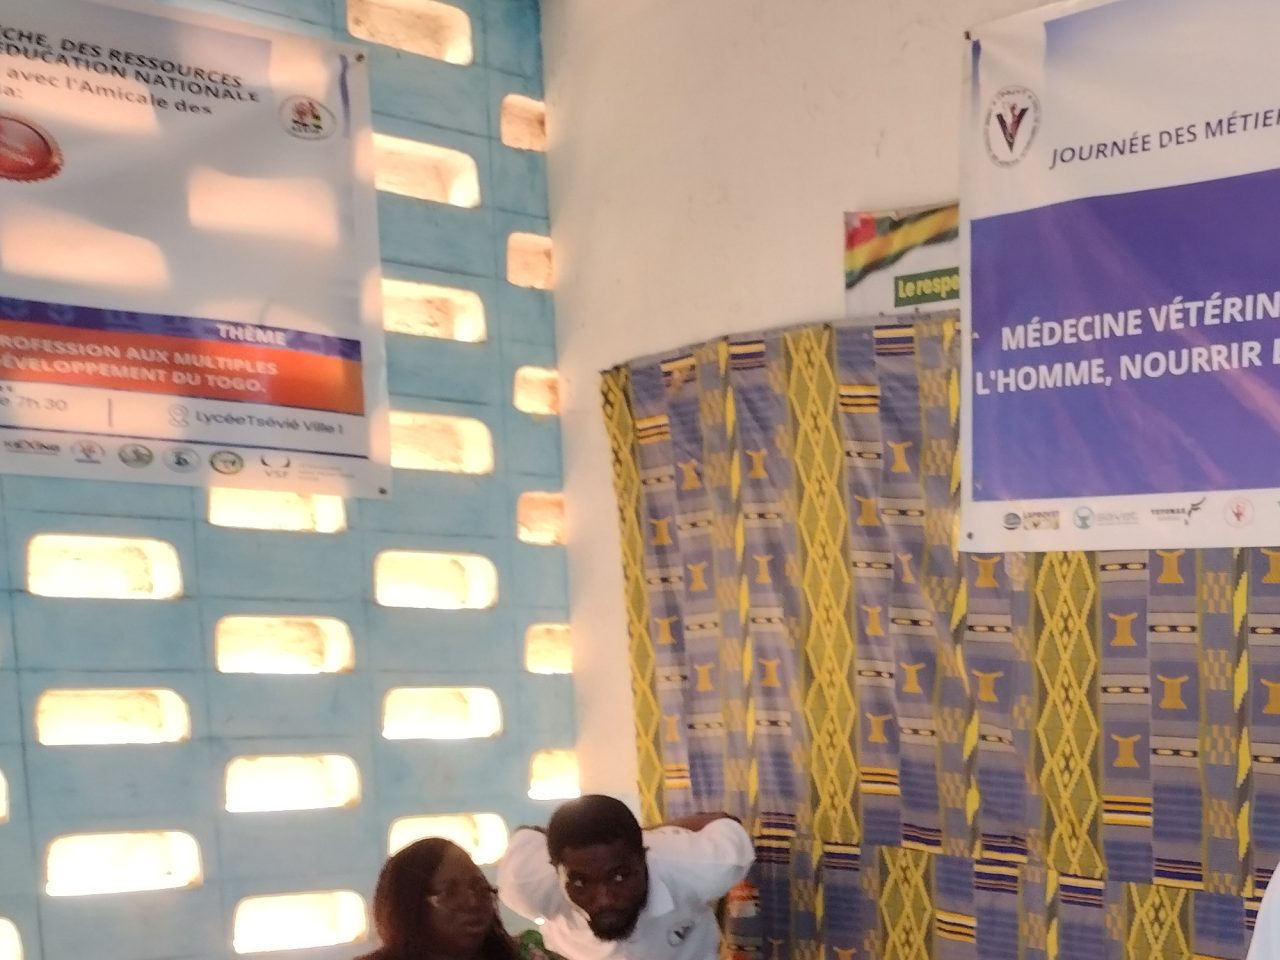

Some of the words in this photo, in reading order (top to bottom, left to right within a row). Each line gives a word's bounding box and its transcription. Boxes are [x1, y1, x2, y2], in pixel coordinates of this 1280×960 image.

[61, 38, 102, 57] DES
[108, 48, 242, 88] RESSOURCES
[7, 67, 60, 88] avec
[65, 75, 168, 109] l'Amicale
[174, 100, 212, 114] des
[134, 69, 260, 103] NATIONALE
[1049, 131, 1151, 170] JOURNÉE
[1159, 124, 1197, 148] DES
[1002, 309, 1143, 351] MÉDECINE
[127, 346, 169, 365] AUX
[173, 352, 278, 375] MULTIPLES
[172, 371, 201, 386] DU
[975, 352, 1113, 396] L'HOMME,
[1120, 341, 1263, 381] NOURRIR
